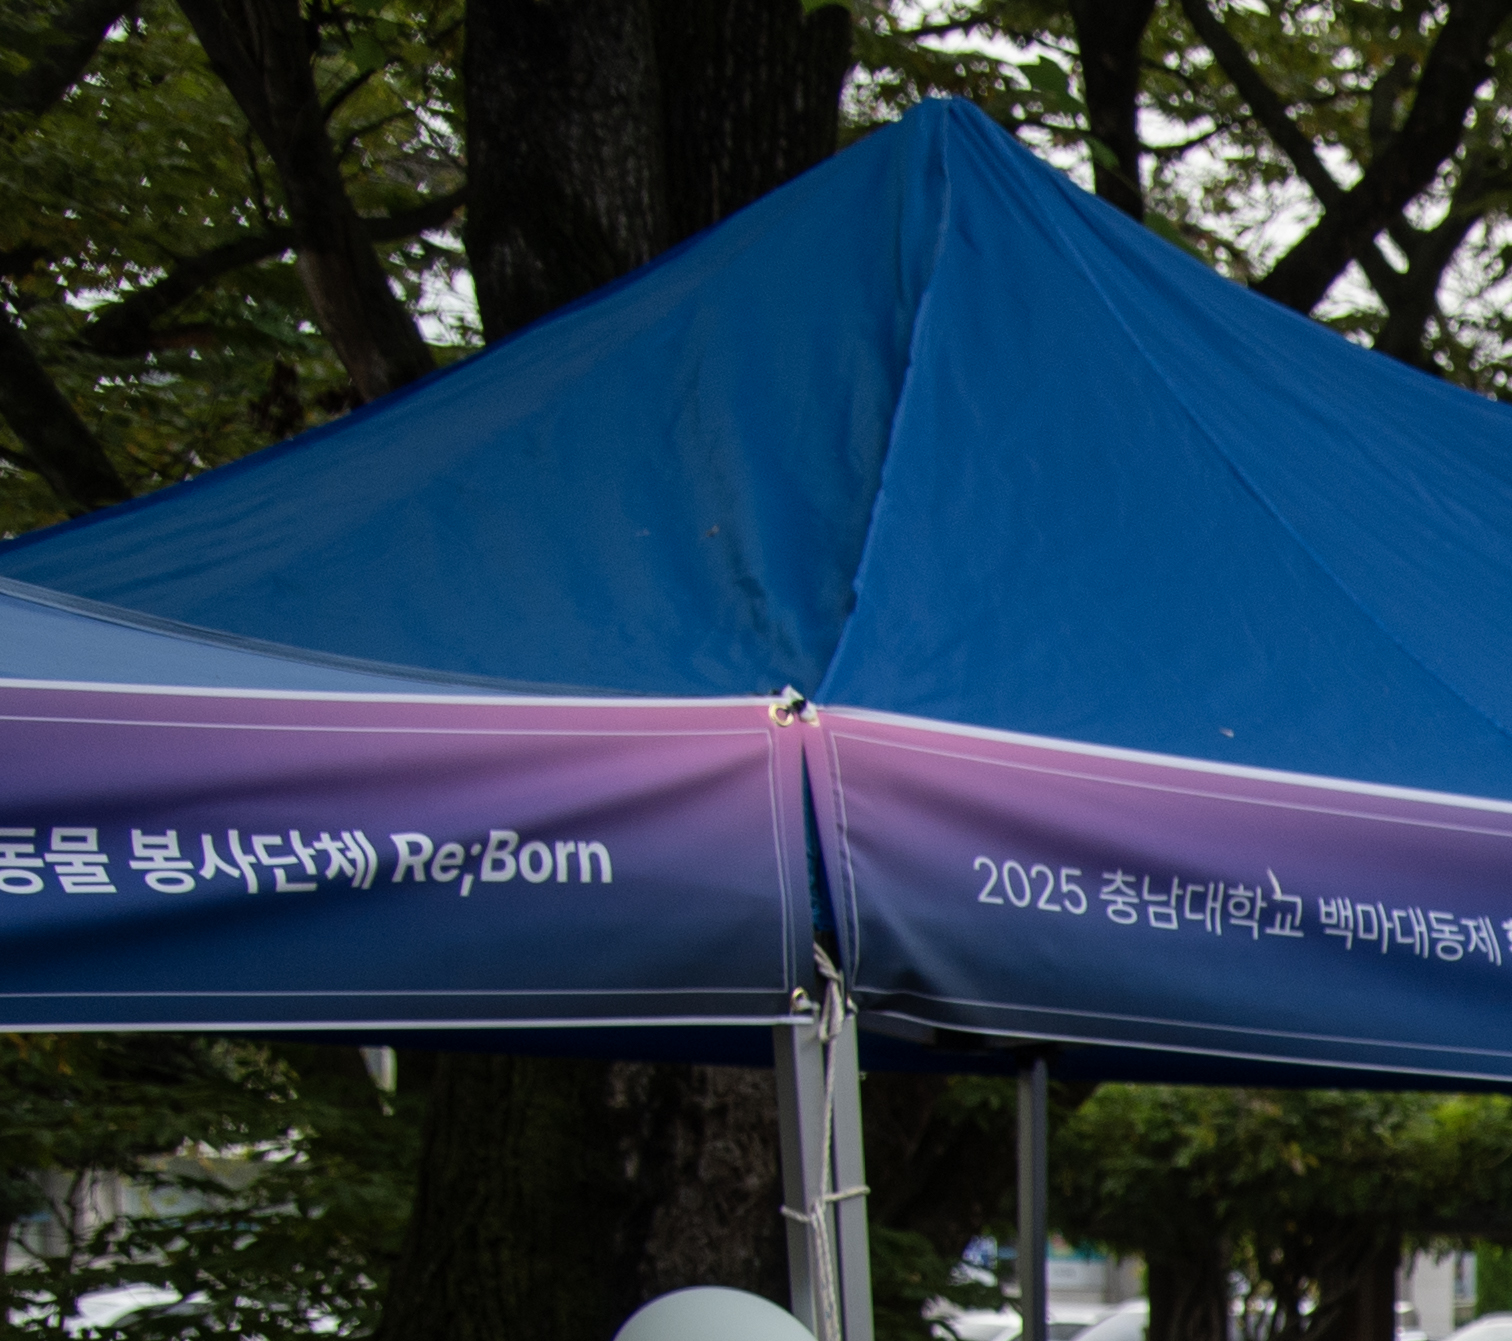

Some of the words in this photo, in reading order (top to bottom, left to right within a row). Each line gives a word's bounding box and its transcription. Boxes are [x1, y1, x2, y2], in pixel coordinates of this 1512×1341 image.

[0, 827, 118, 894] 동물
[129, 828, 378, 894] 봉사단체
[973, 856, 1088, 915] 2025
[1099, 866, 1305, 940] 충남대학교
[1318, 896, 1502, 967] 백마대동제
